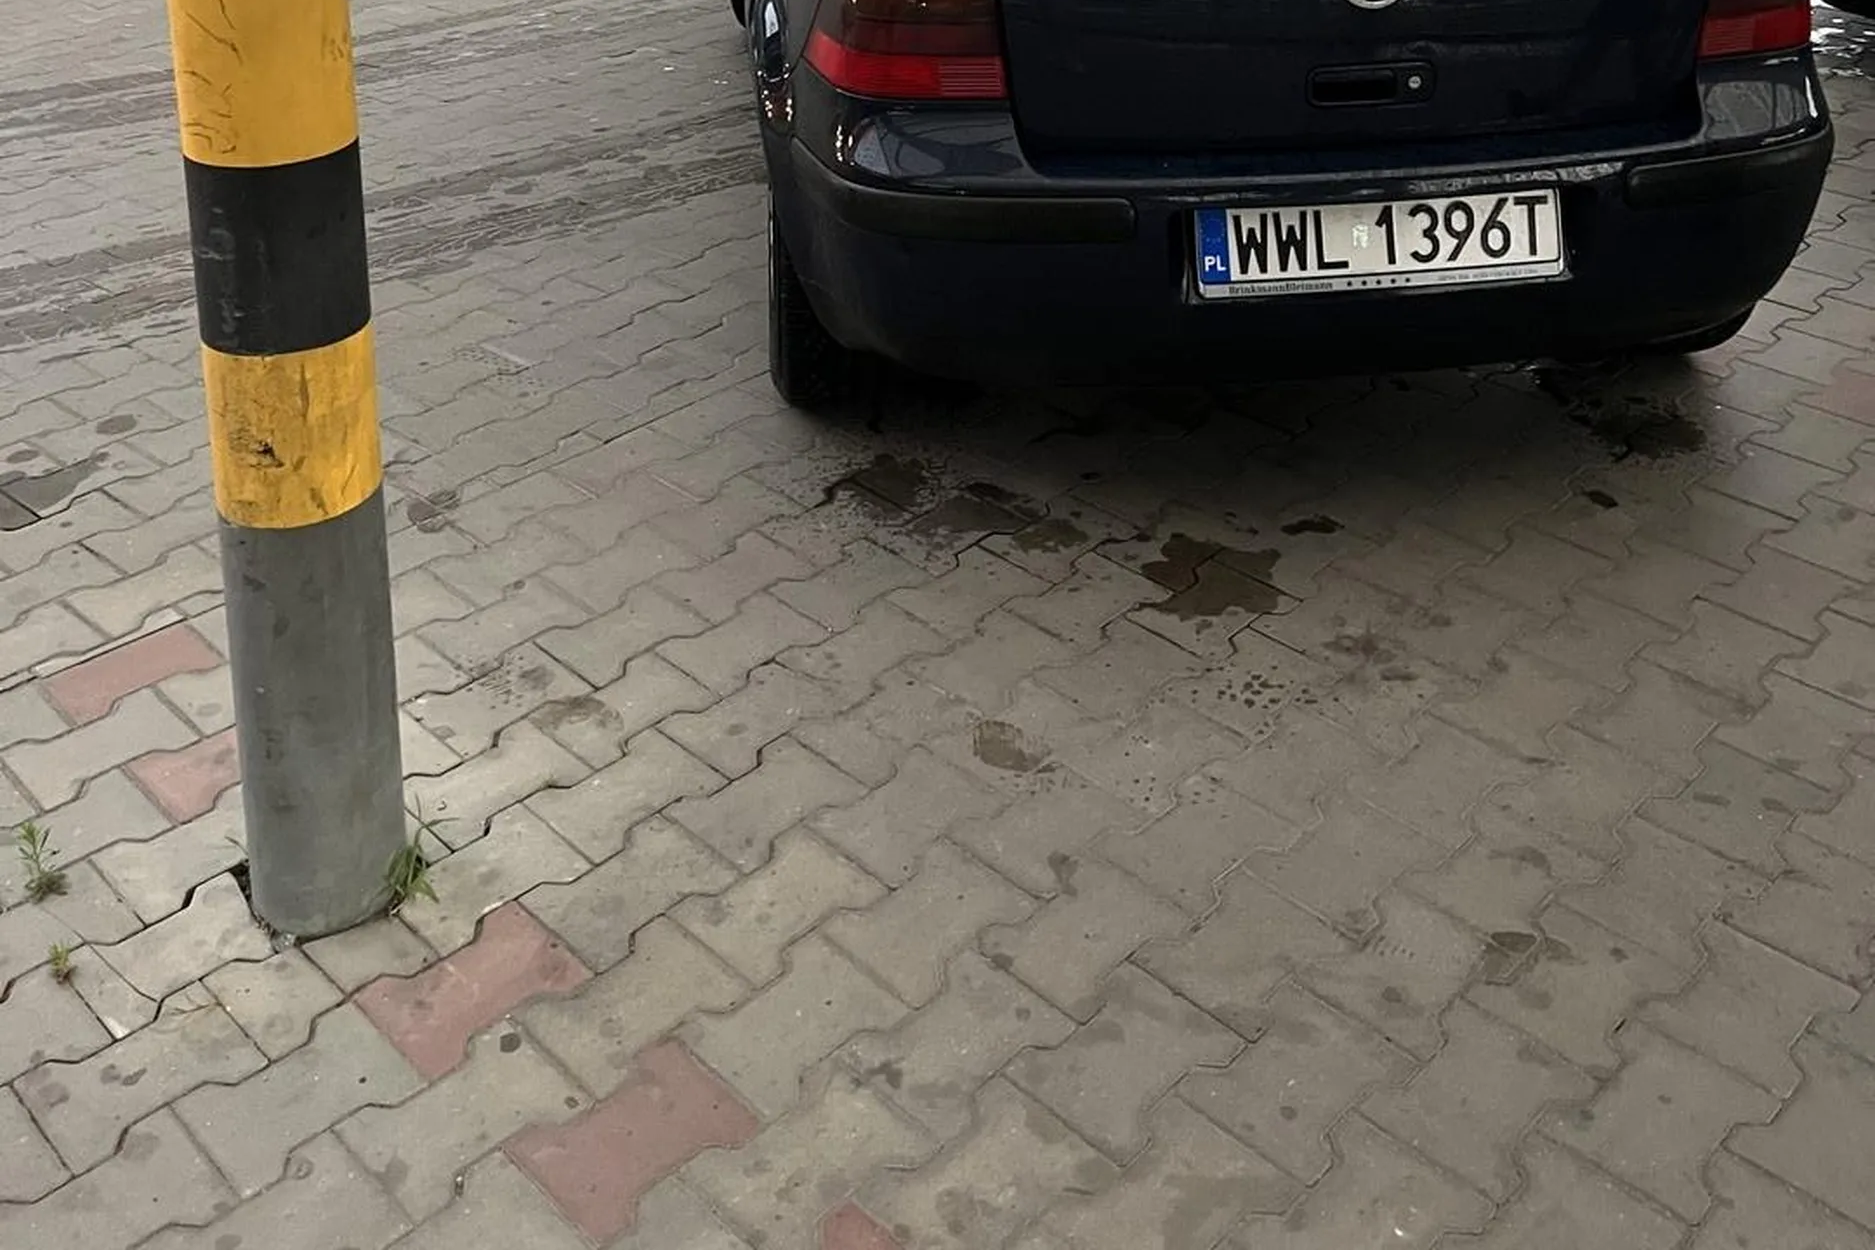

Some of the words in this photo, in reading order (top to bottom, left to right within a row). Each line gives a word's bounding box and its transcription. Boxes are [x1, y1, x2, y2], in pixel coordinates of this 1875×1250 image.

[1232, 210, 1350, 275] WWL
[1374, 195, 1549, 265] 1396T
[1204, 255, 1227, 272] PL
